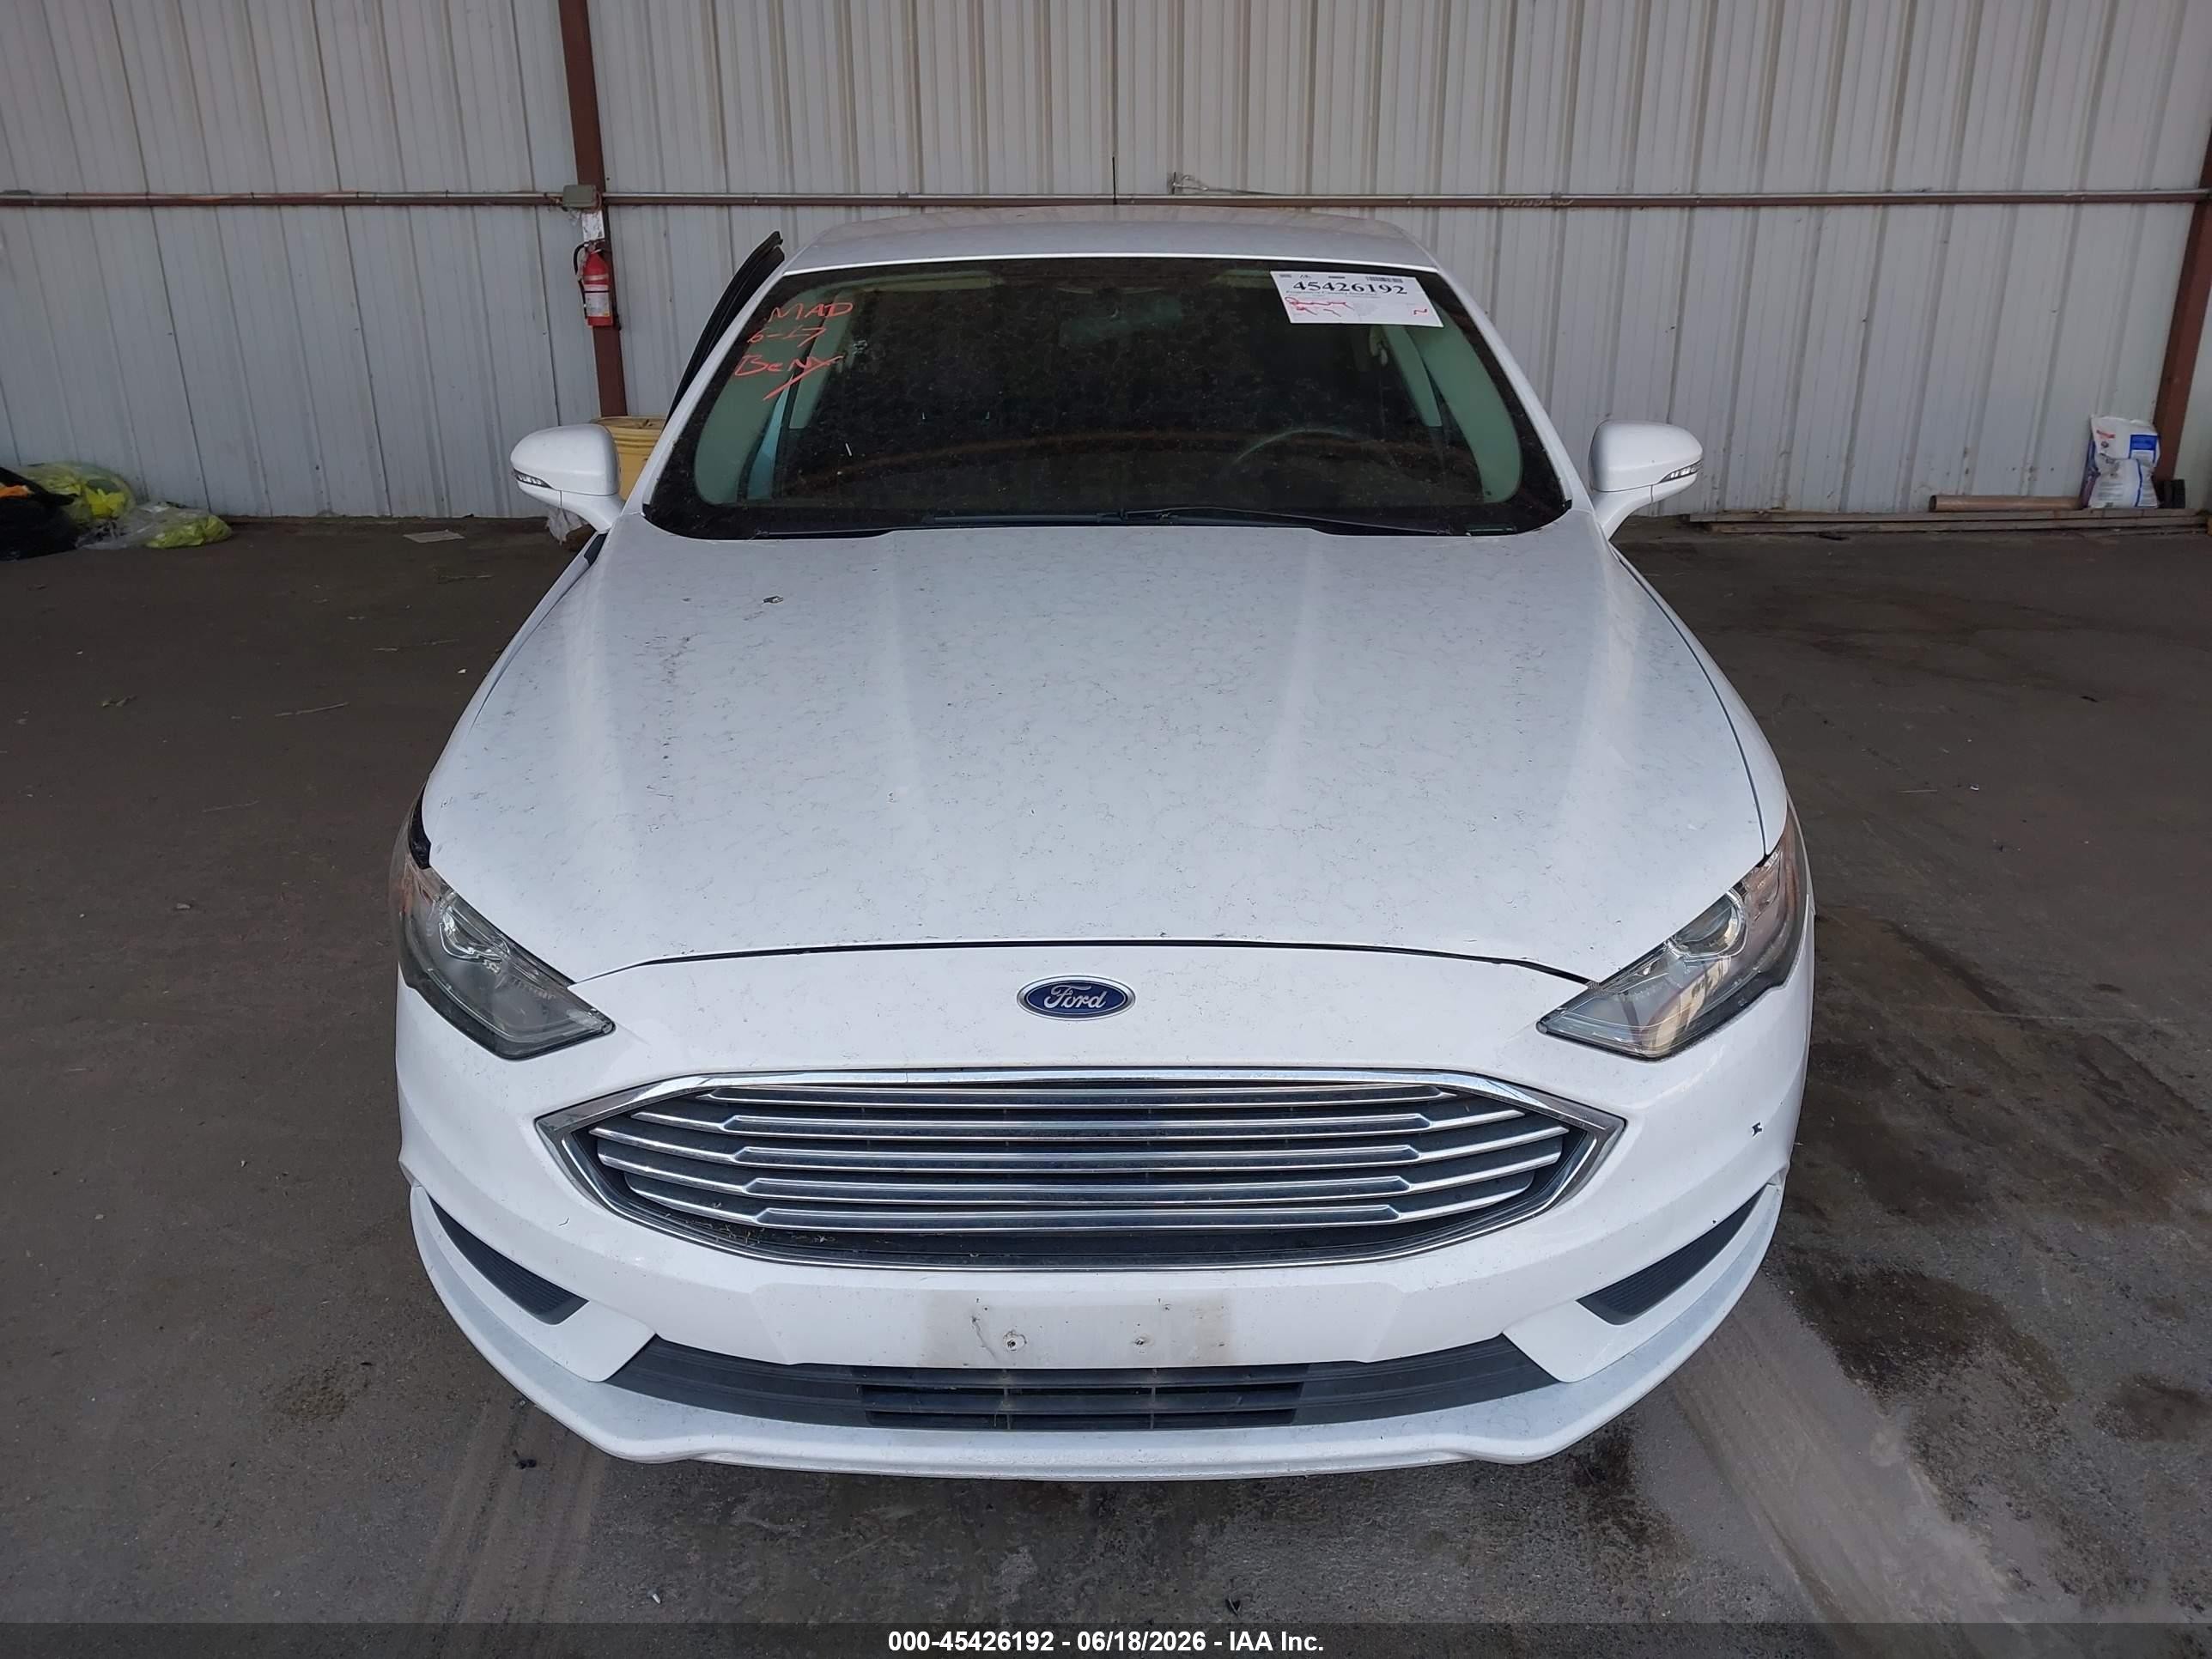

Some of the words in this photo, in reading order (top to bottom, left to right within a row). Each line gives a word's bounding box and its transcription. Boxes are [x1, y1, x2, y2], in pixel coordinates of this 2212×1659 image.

[1292, 281, 1408, 295] 45426192
[768, 301, 854, 323] MAD
[747, 324, 828, 348] 6-17
[1043, 984, 1108, 1009] Ford
